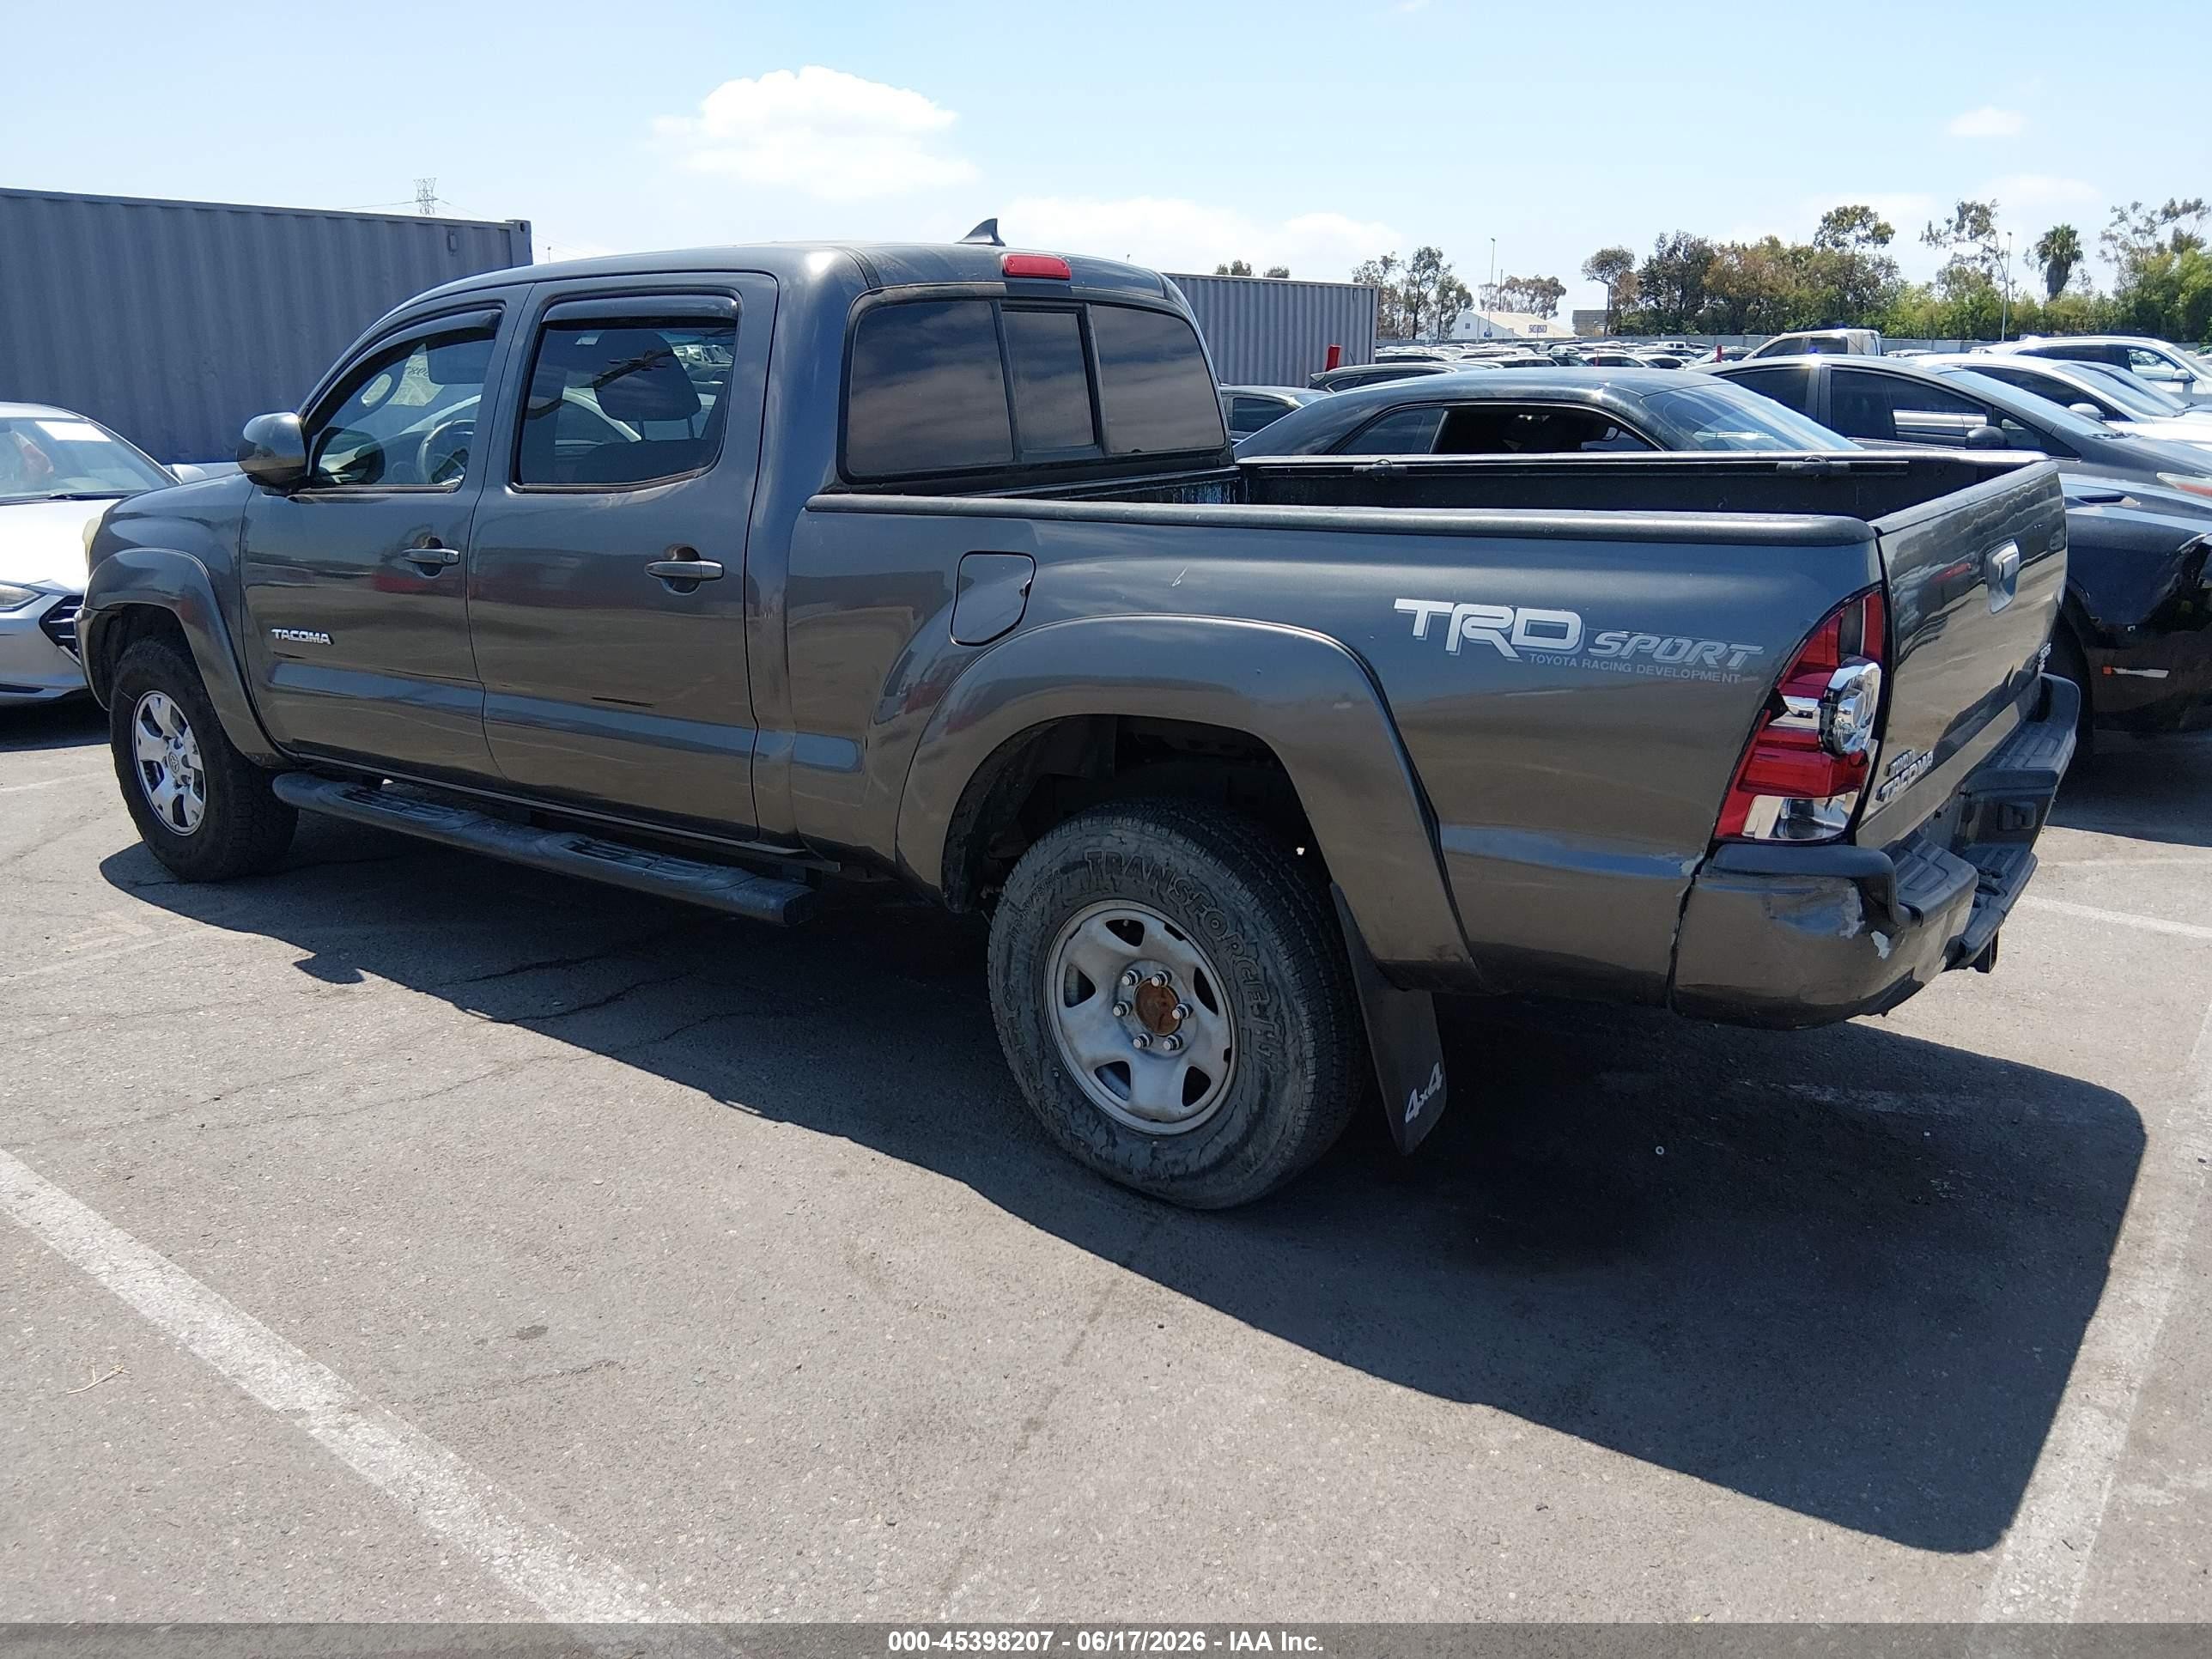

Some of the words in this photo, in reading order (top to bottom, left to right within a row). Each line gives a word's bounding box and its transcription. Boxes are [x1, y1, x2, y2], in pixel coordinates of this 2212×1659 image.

[270, 629, 331, 645] TACOMA
[1394, 599, 1584, 661] TRD
[1588, 631, 1764, 669] SPORT
[1529, 653, 1577, 667] TOYOTA
[1581, 659, 1632, 672] RACING
[1636, 664, 1741, 684] DEVELOPMENT
[1084, 848, 1270, 1003] TRANSFORCE
[1405, 1061, 1443, 1123] 4x4
